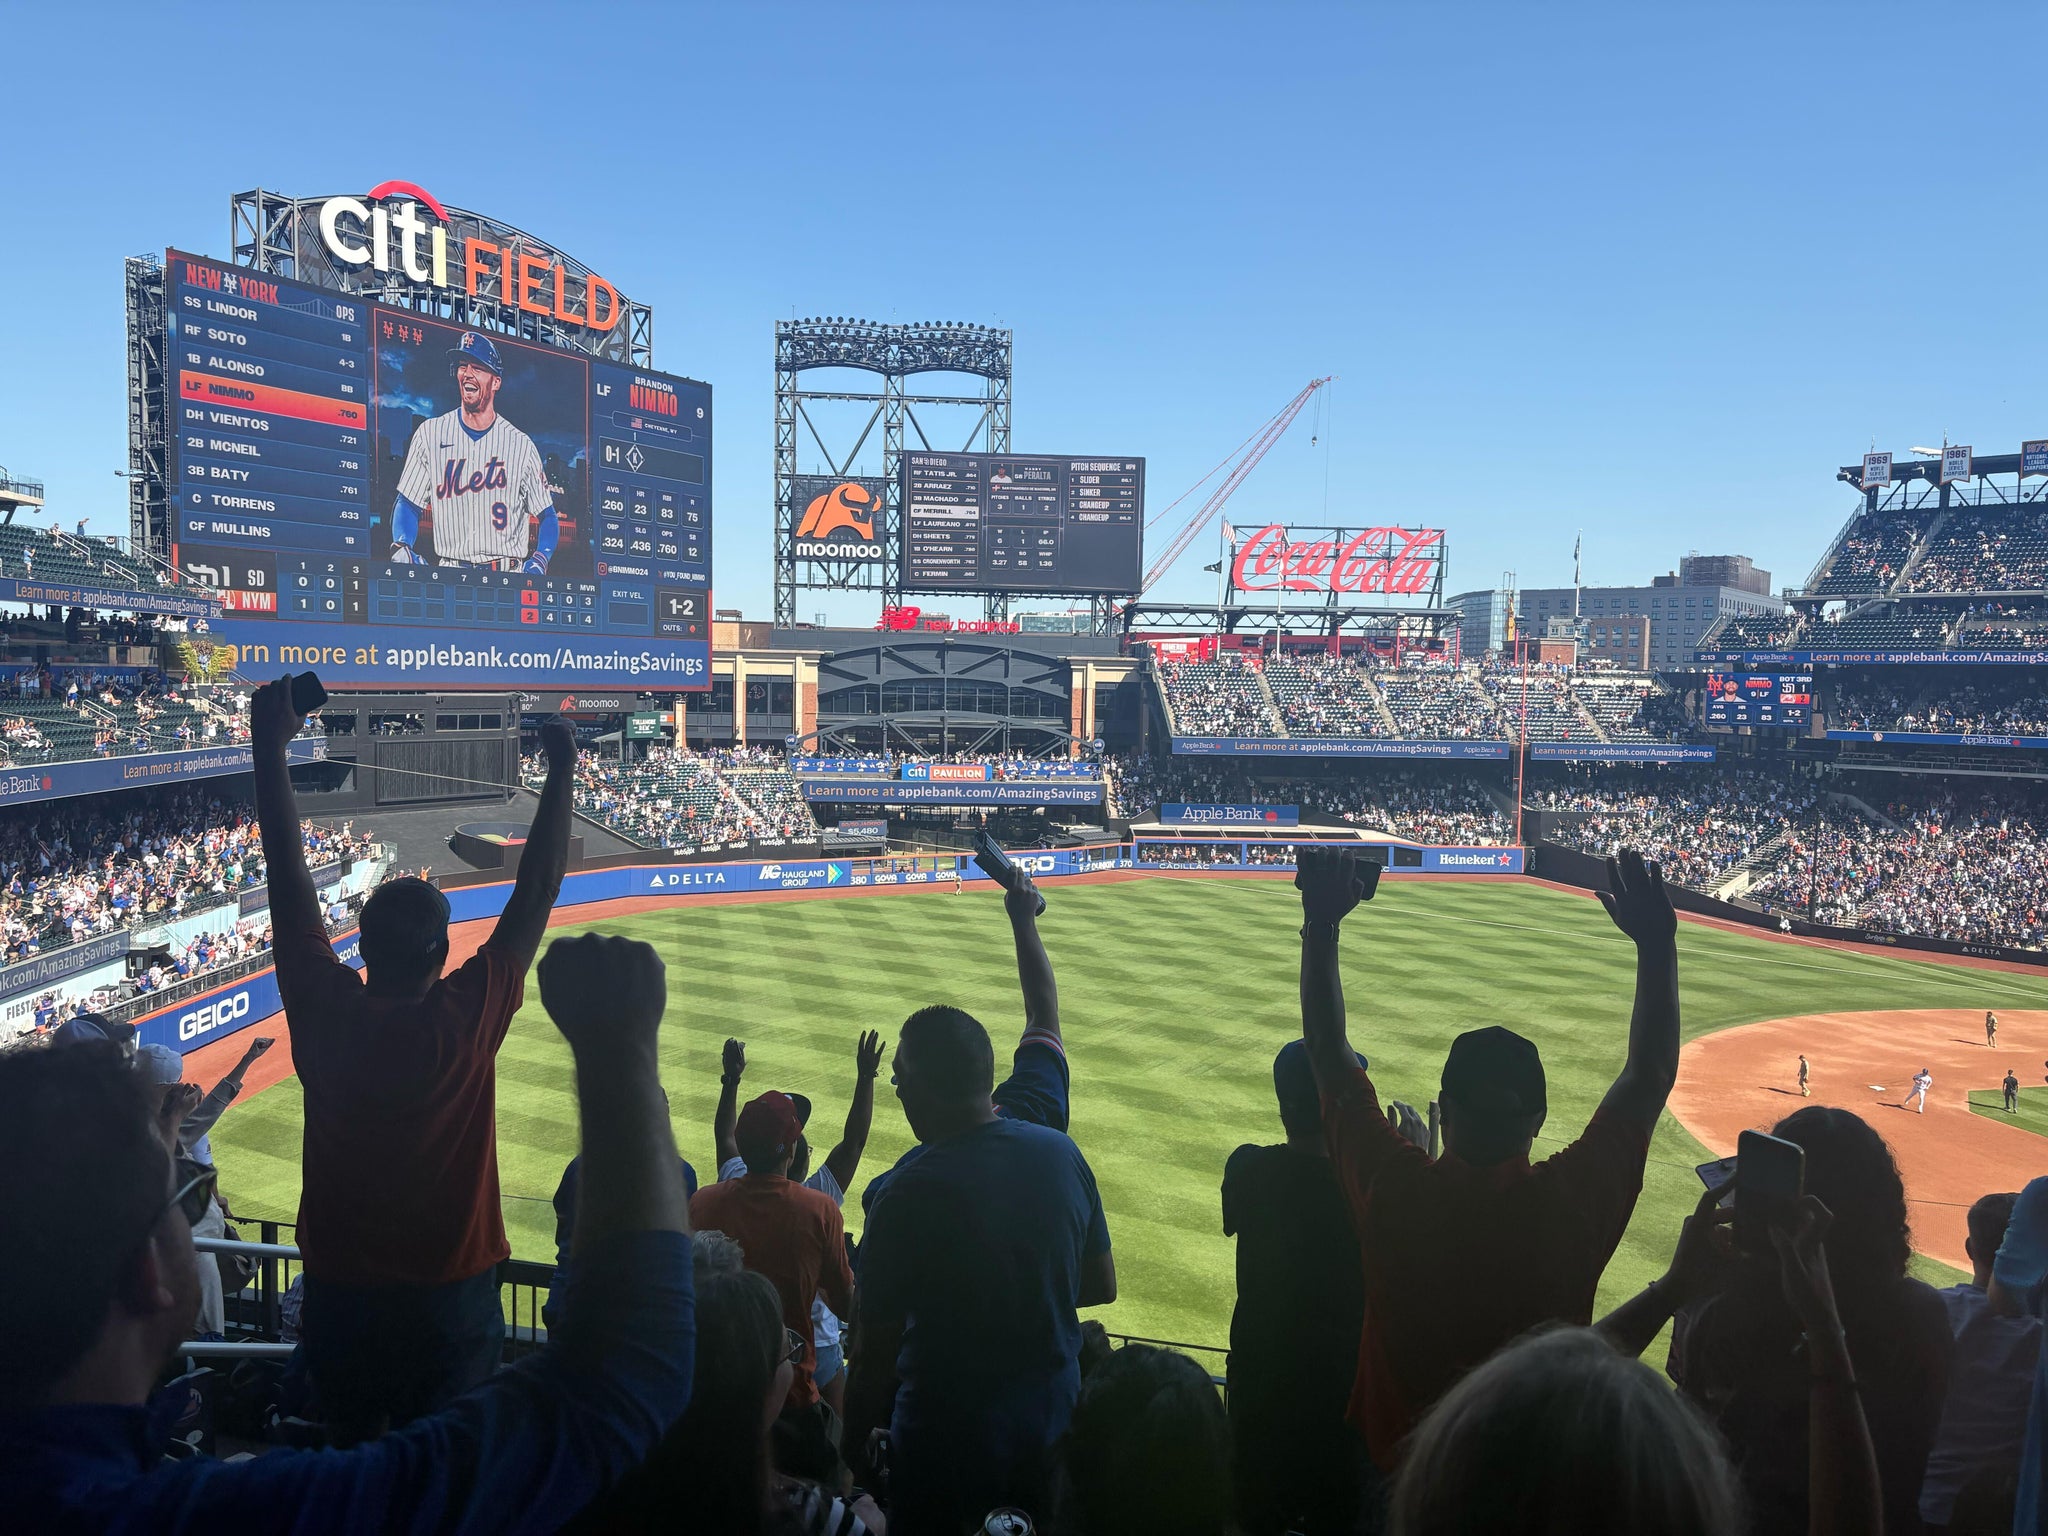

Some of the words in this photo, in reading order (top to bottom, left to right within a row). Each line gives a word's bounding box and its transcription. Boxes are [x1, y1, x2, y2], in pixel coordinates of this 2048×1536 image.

[319, 196, 447, 288] citi
[465, 237, 619, 331] FIELD
[186, 263, 221, 291] NEW
[239, 276, 279, 305] YORK
[184, 295, 202, 309] SS
[207, 300, 258, 322] LINDOR
[335, 304, 355, 322] OPS
[184, 324, 202, 336] RF
[208, 328, 247, 346] SOTO
[338, 358, 355, 369] 4-3
[186, 353, 201, 364] 1B
[208, 356, 265, 377] ALONSO
[341, 384, 353, 393] BB
[635, 376, 673, 393] BRANDON
[185, 380, 202, 391] LF
[208, 383, 255, 401] NIMMO
[337, 409, 358, 419] .760
[596, 383, 611, 397] LF
[629, 384, 678, 417] NIMMO
[697, 408, 704, 418] 9
[185, 408, 204, 421] DH
[209, 411, 270, 432] VIENTOS
[339, 435, 357, 445] .721
[187, 437, 204, 448] 2B
[210, 439, 261, 457] MCNEIL
[338, 460, 359, 470] .768
[1868, 456, 1888, 464] 1969
[1946, 450, 1966, 459] 1986
[912, 457, 923, 465] SAN
[929, 457, 947, 467] DIEGO
[1071, 463, 1089, 471] PITCH
[1089, 462, 1121, 472] SEQUENCE
[187, 465, 205, 476] 3B
[210, 467, 250, 482] BATY
[340, 485, 358, 495] .761
[436, 456, 508, 500] Mets
[1023, 470, 1052, 481] PERALTA
[1080, 476, 1100, 484] SLIDER
[1080, 488, 1100, 497] SINKER
[211, 494, 276, 512] TORRENS
[339, 511, 359, 520] .633
[602, 500, 624, 512] .260
[634, 504, 647, 515] 23
[661, 508, 674, 519] 83
[686, 512, 698, 522] 75
[1079, 500, 1110, 510] CHANGEUP
[491, 501, 508, 531] 9
[1079, 513, 1109, 522] CHANGEUP
[189, 521, 206, 532] CF
[211, 522, 271, 538] MULLINS
[602, 537, 624, 549] .324
[630, 541, 651, 552] .436
[657, 544, 677, 555] .760
[688, 547, 698, 557] 12
[796, 543, 882, 558] moomoo
[608, 565, 649, 576] @BNIMMO24
[247, 569, 265, 587] SD
[15, 580, 43, 599] Learn
[45, 586, 70, 602] more
[71, 588, 81, 602] at
[83, 590, 208, 616] applebank.com/AmazingSavings
[242, 591, 271, 610] NYM
[669, 598, 695, 616] 1-2
[924, 620, 954, 631] new
[958, 618, 1020, 633] balance
[279, 645, 347, 664] more
[355, 644, 379, 665] at
[386, 643, 703, 676] applebank.com/AmazingSavings
[1810, 652, 1840, 662] Learn
[1874, 653, 1885, 662] at
[579, 698, 620, 708] moomoo
[1960, 736, 1987, 746] Apple
[1988, 736, 2011, 745] Bank
[1234, 742, 1260, 750] Learn
[1300, 742, 1451, 755] applebank.com/AmazingSavings
[1588, 747, 1713, 759] applebank.com/AmazingSavings
[123, 761, 148, 780] Learn
[150, 761, 172, 776] more
[174, 758, 182, 772] at
[933, 768, 983, 778] PAVILION
[9, 774, 41, 794] Bank
[808, 784, 843, 798] Learn
[846, 787, 879, 797] more
[882, 786, 895, 798] at
[897, 785, 1097, 801] applebank.com/AmazingSavings
[1181, 806, 1224, 823] Apple
[1224, 807, 1262, 821] Bank
[700, 843, 721, 853] HubSpot
[728, 839, 749, 849] HubSpot
[759, 837, 786, 847] HubSpot
[791, 836, 817, 846] HubSpot
[673, 847, 695, 857] HubSpot
[1119, 860, 1132, 868] 370
[1439, 853, 1495, 866] Heineken
[669, 872, 726, 886] DELTA
[781, 869, 825, 879] HAUGLAND
[850, 875, 867, 885] 380
[874, 873, 898, 883] GOYA
[905, 872, 928, 882] GOYA
[935, 871, 956, 880] GOYA
[782, 879, 808, 887] GROUP
[1971, 946, 2001, 956] DELTA
[179, 990, 250, 1041] GEICO
